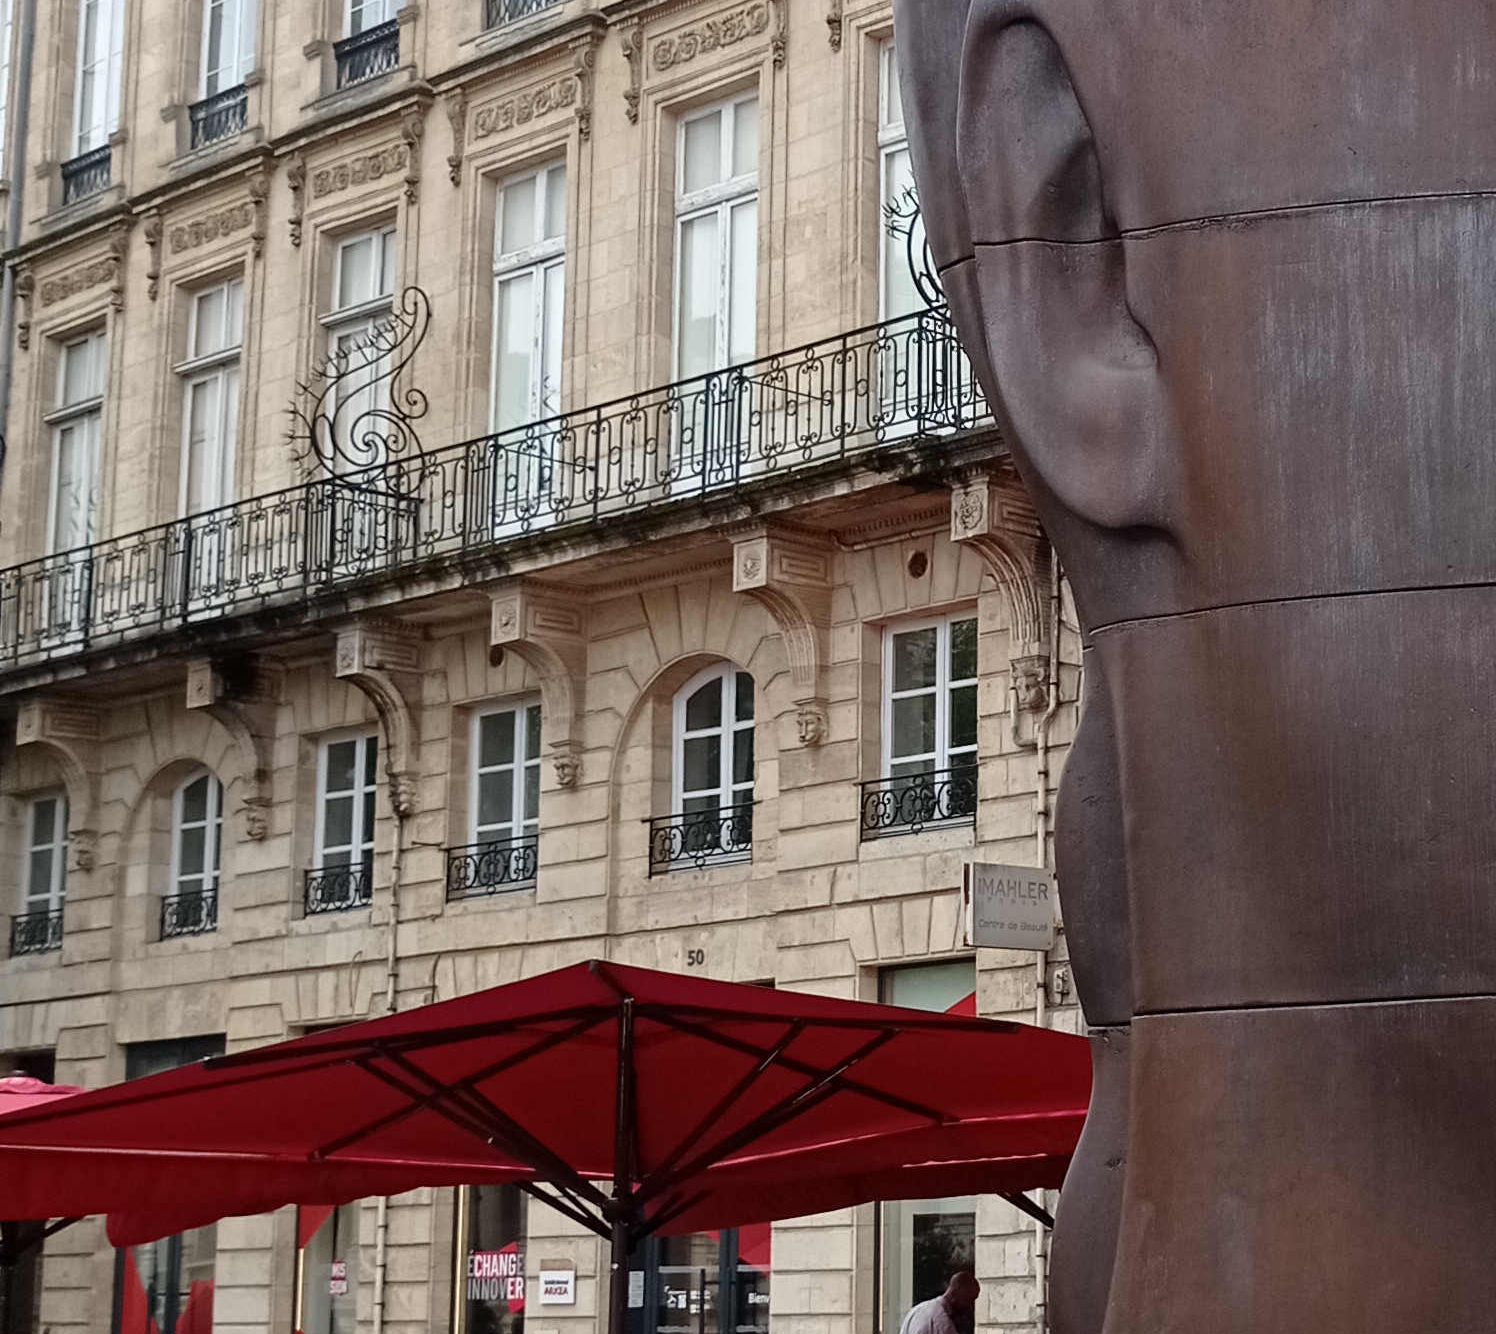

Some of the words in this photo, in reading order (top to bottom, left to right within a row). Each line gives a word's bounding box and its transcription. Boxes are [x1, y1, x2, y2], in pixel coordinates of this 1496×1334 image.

[983, 878, 1048, 900] MAHLER
[979, 919, 1005, 929] Centre
[1008, 922, 1017, 930] de
[687, 949, 705, 966] 50
[467, 1277, 524, 1300] INNOVER
